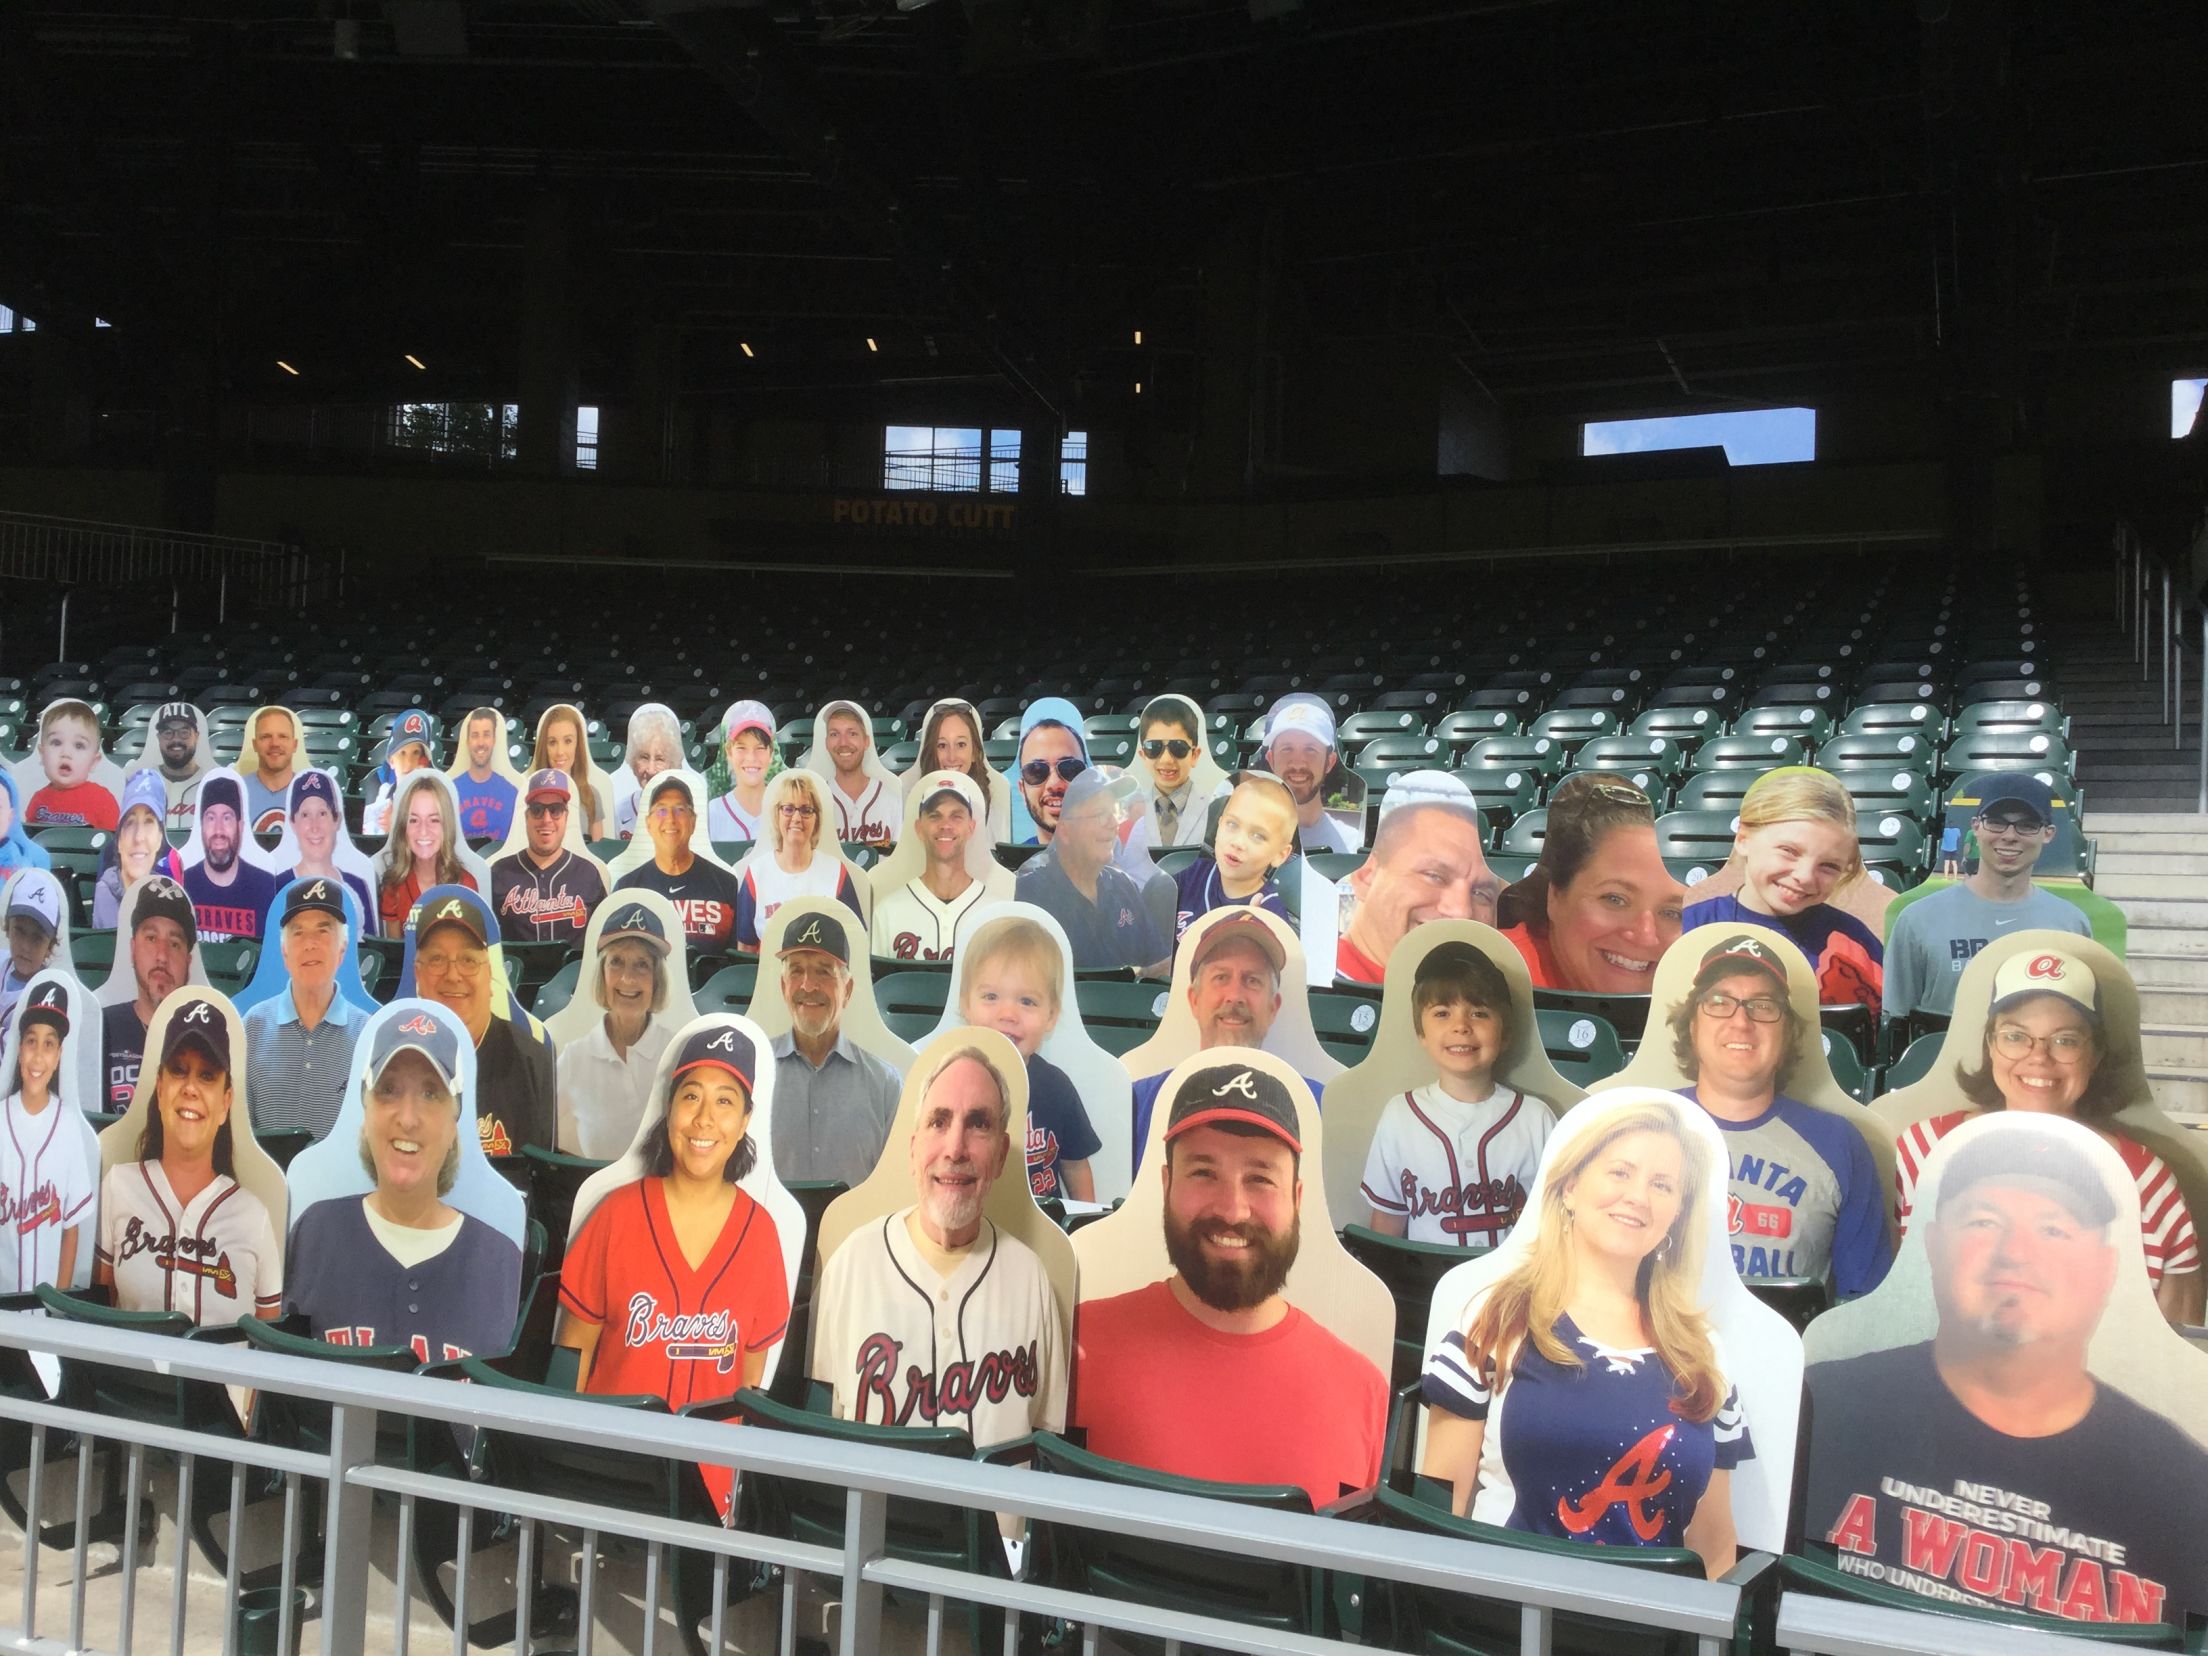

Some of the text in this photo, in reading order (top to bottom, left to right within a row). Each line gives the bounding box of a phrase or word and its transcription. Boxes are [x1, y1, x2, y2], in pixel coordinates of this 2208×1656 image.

[833, 499, 1015, 528] POTATO CUTT
[163, 702, 189, 718] ATL
[302, 879, 326, 900] A
[501, 884, 574, 916] Atlanta
[436, 899, 463, 919] A
[620, 902, 646, 931] A
[797, 919, 823, 945] A
[1725, 938, 1763, 958] A
[183, 1002, 210, 1024] A
[707, 1031, 734, 1052] A
[1212, 1071, 1258, 1100] A
[1400, 1167, 1523, 1220] Braves
[1728, 1152, 1808, 1208] NTA
[1757, 1212, 1779, 1230] 66
[118, 1216, 217, 1268] Braves
[625, 1291, 729, 1347] Braves
[855, 1332, 1037, 1426] Braves
[1557, 1423, 1676, 1541] A
[1953, 1479, 2052, 1522] NEVER
[1881, 1475, 2127, 1566] UNDERESTIMATE
[1827, 1493, 2167, 1624] A WOMAN
